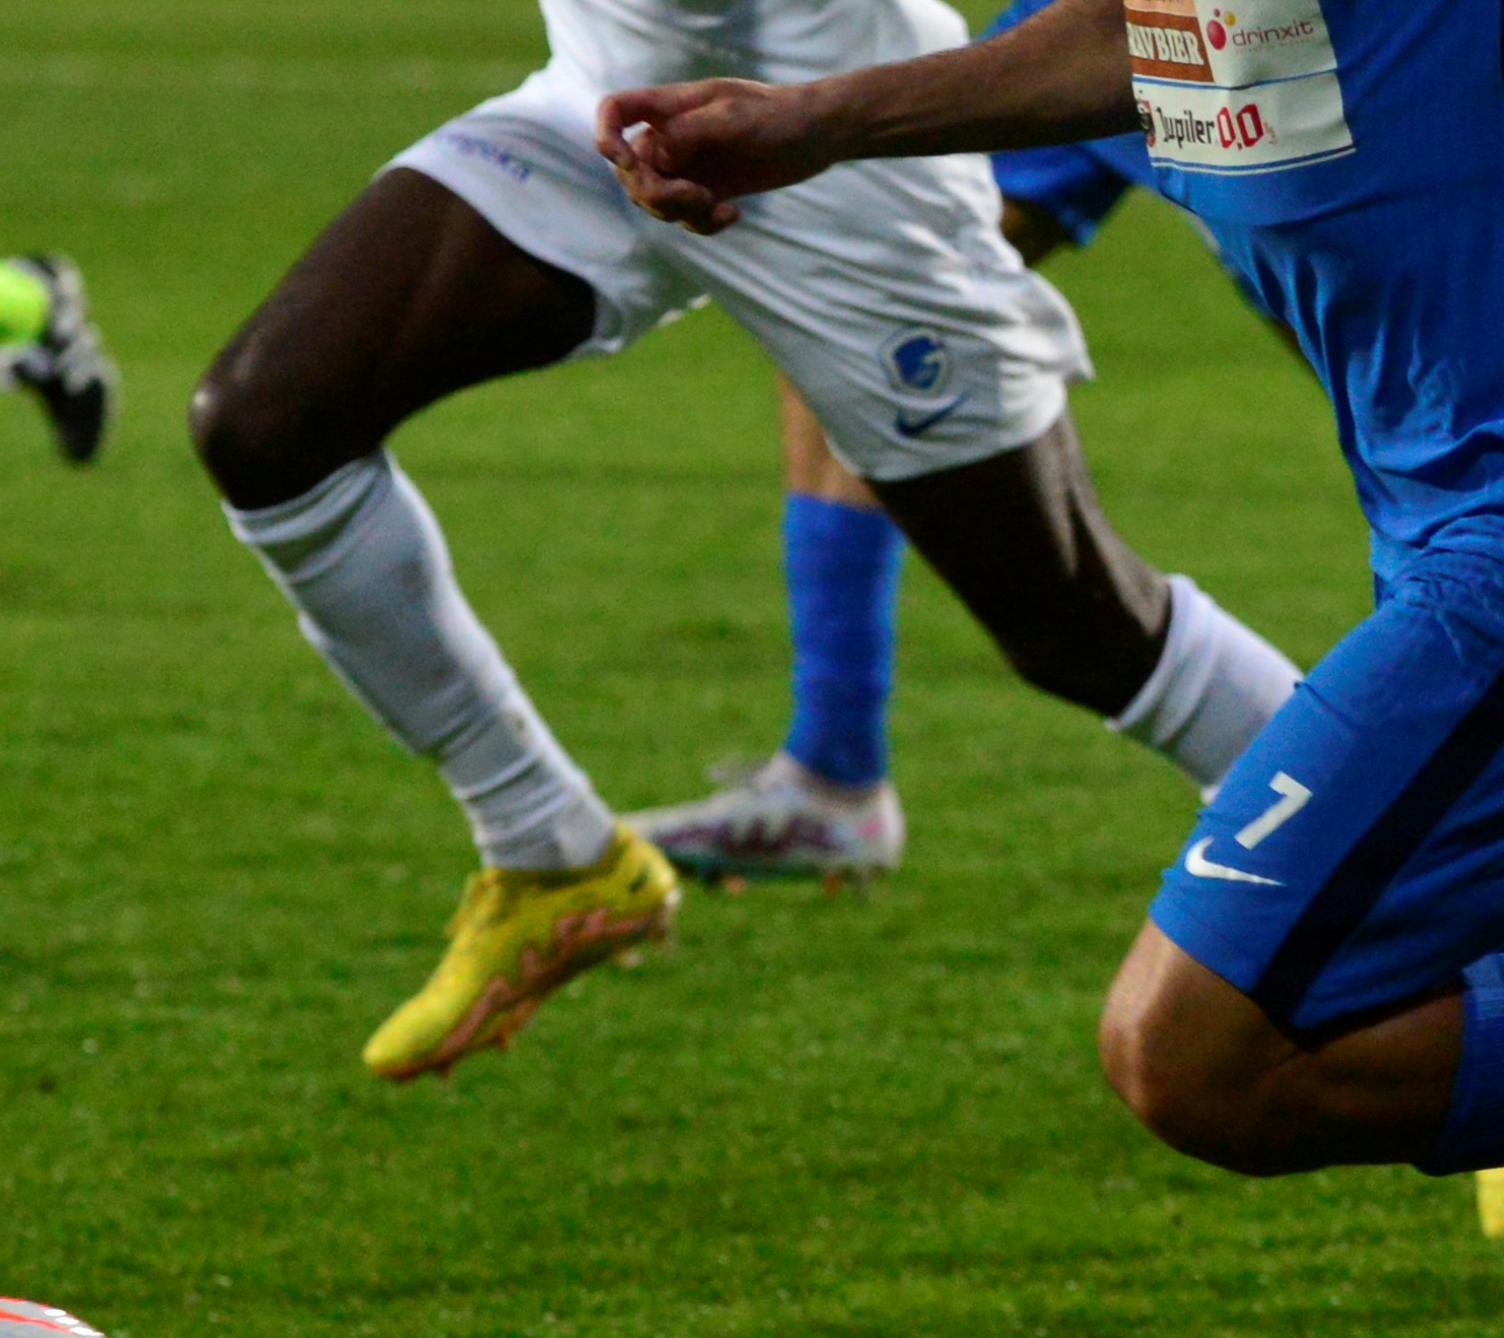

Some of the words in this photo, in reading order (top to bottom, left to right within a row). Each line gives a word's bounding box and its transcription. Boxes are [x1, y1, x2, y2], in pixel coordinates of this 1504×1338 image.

[1232, 20, 1314, 47] drinxit
[1156, 107, 1215, 149] Jupiler
[1234, 771, 1314, 851] 7
